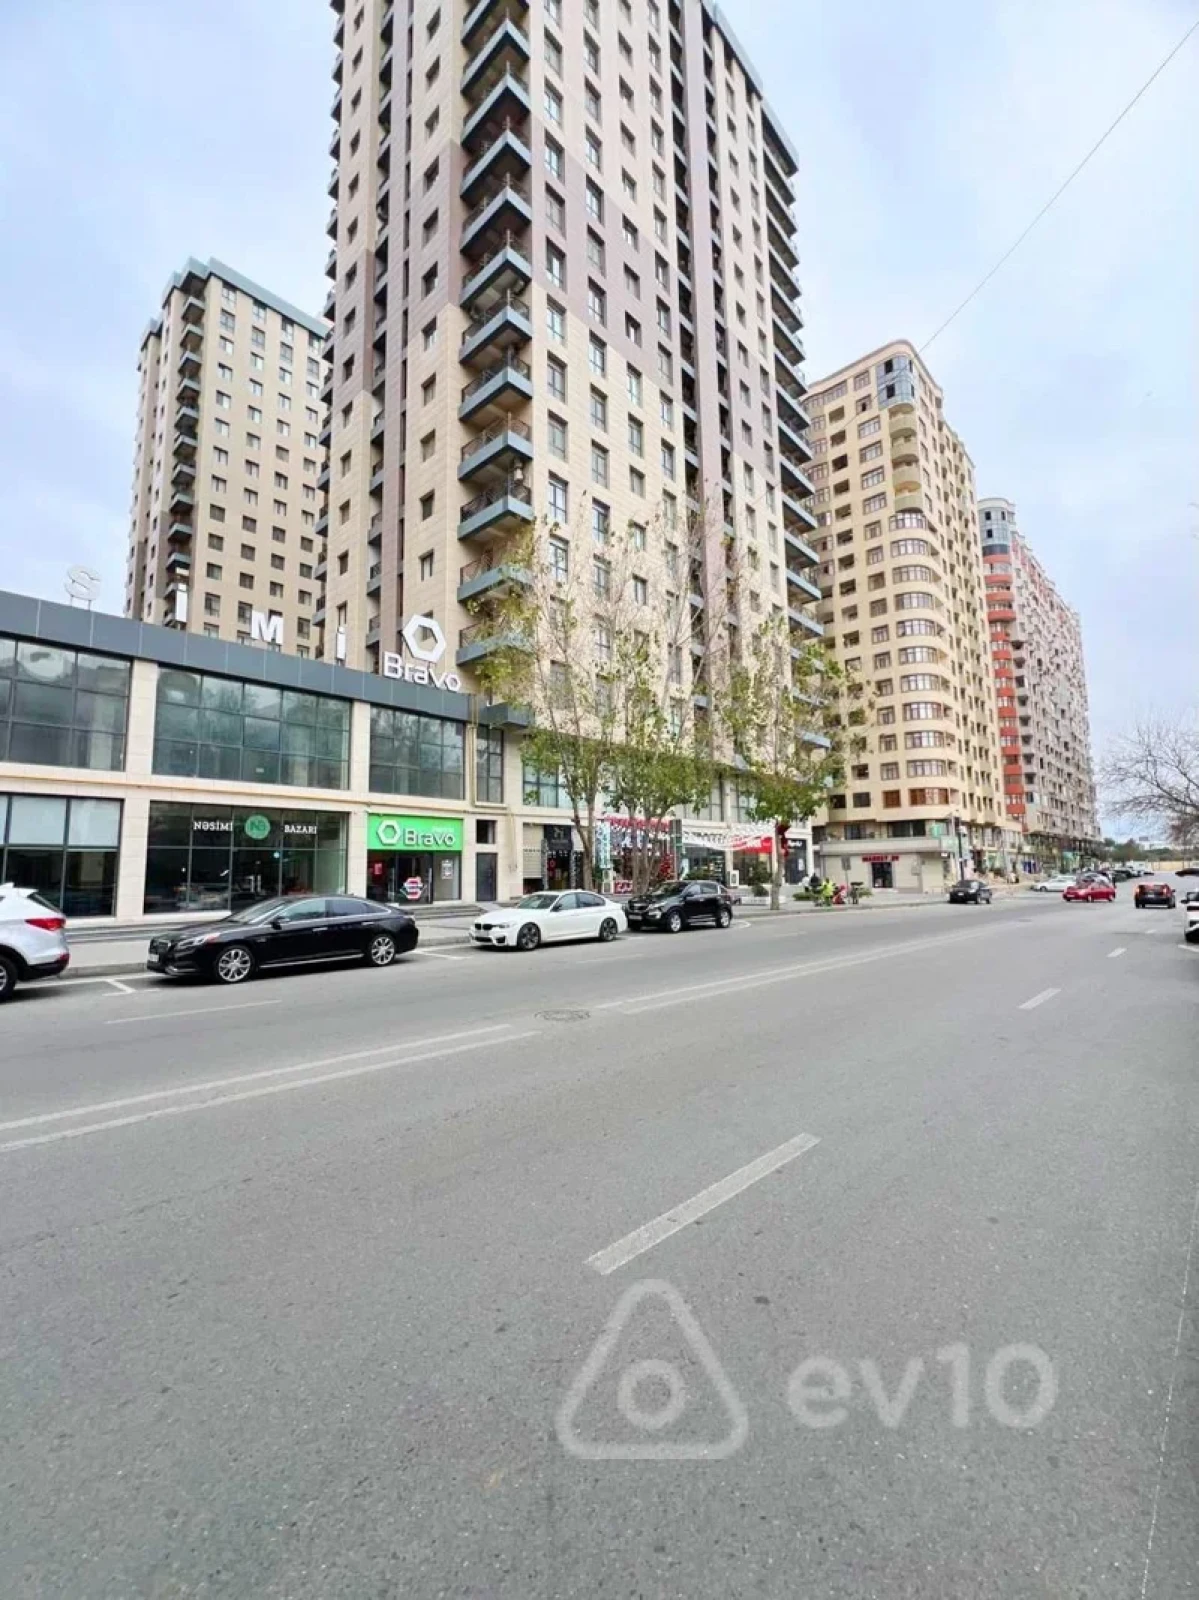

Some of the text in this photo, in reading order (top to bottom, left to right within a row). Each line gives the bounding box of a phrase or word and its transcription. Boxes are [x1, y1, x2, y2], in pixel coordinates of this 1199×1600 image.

[383, 651, 461, 692] Bravo
[284, 824, 318, 835] BAZARI
[404, 828, 456, 846] Bravo
